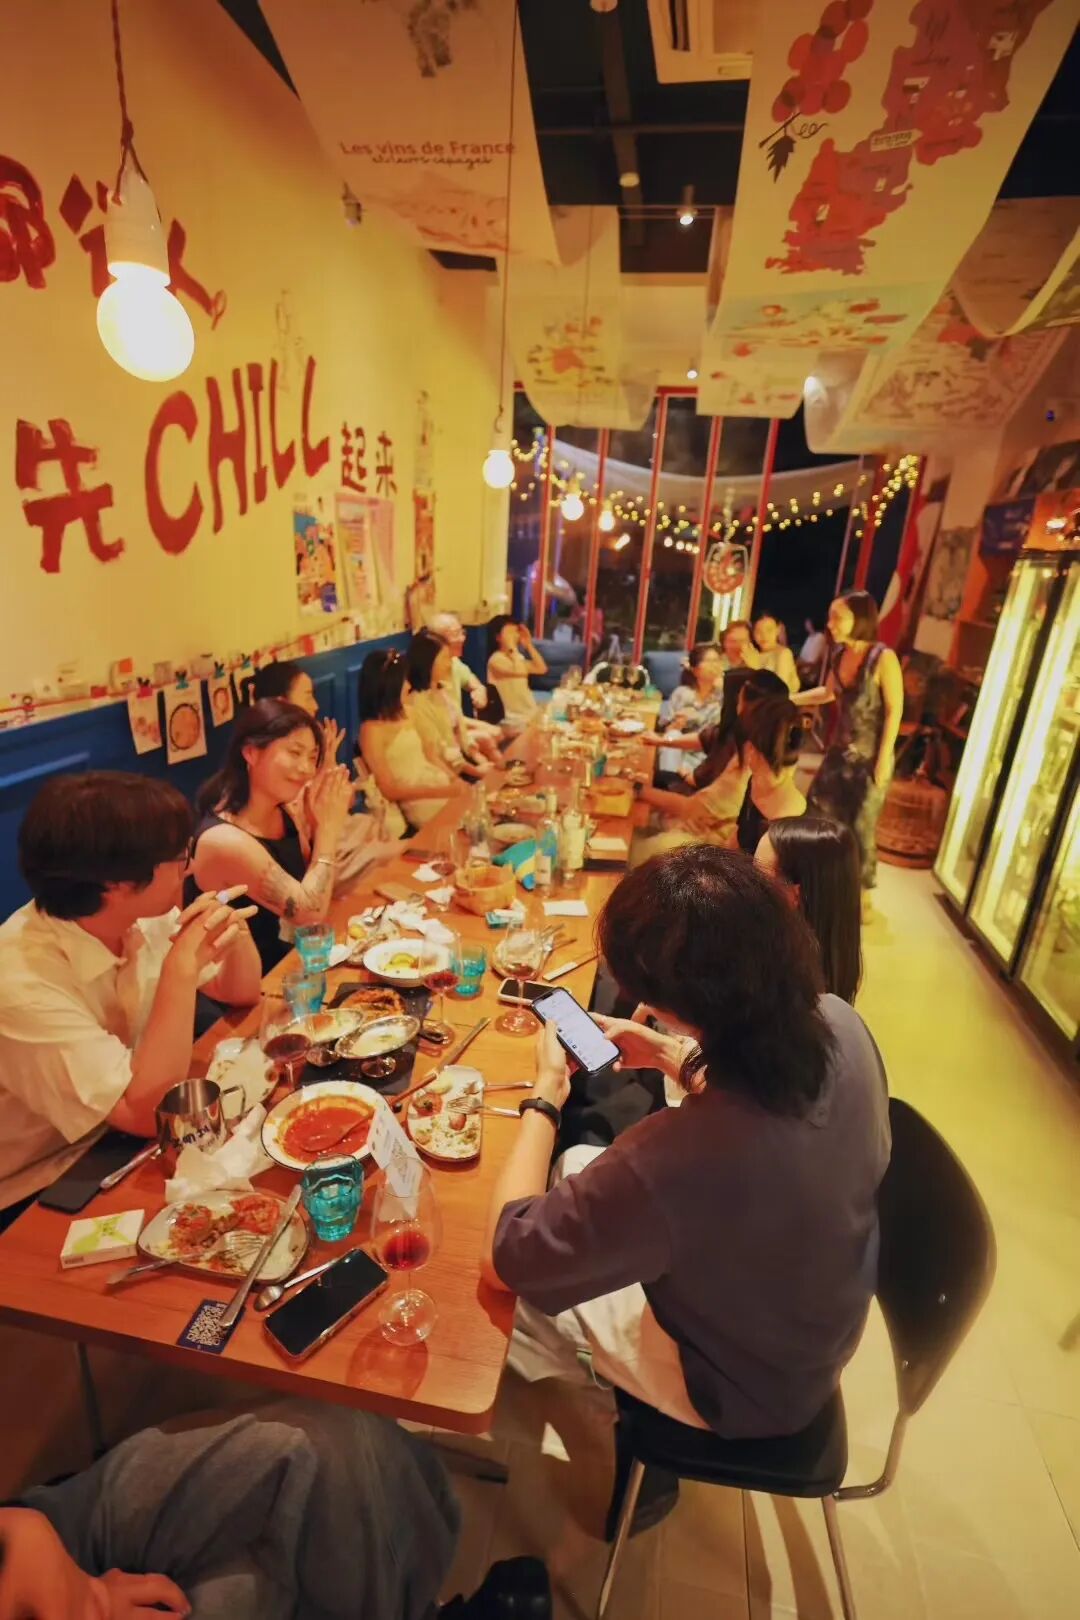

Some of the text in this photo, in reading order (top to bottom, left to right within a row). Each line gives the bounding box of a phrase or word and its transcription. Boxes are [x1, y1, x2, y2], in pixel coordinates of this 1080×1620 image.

[339, 141, 515, 155] Les vins de France
[16, 355, 397, 573] 先 CHILL 起来
